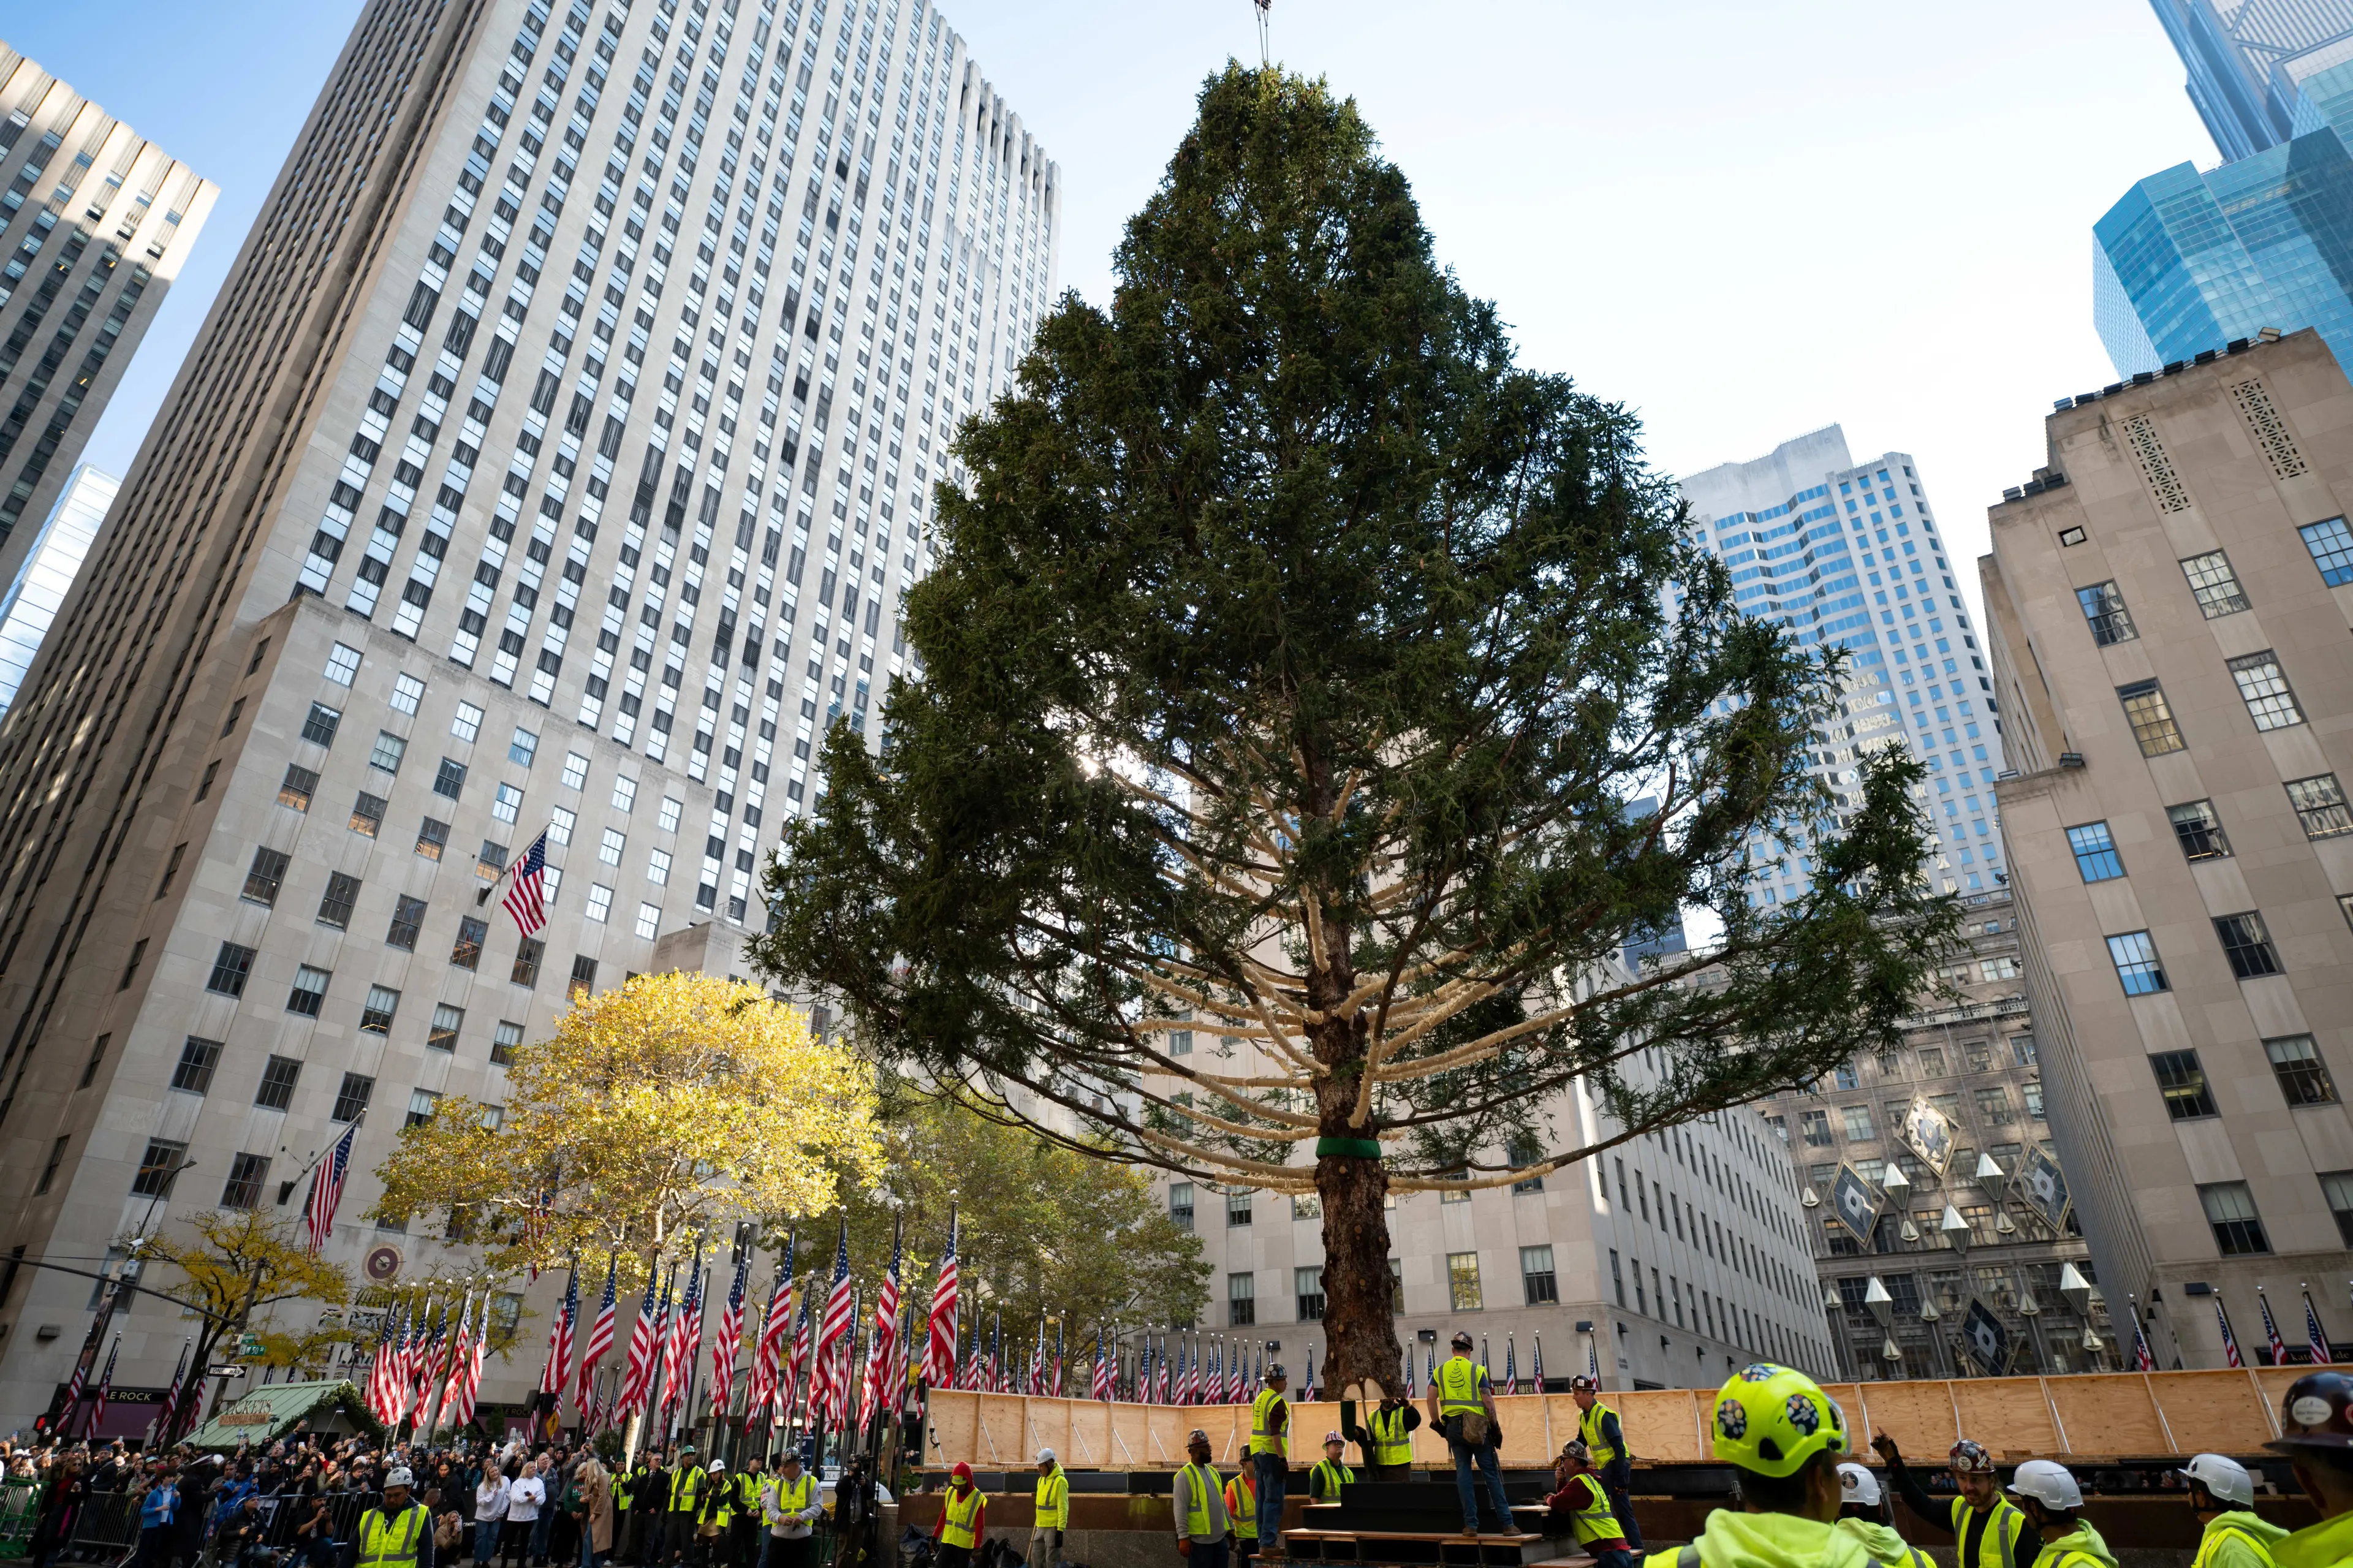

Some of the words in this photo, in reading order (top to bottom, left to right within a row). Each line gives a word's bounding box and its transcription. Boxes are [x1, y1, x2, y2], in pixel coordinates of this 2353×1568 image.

[252, 1346, 259, 1355] 50
[1494, 1385, 1507, 1395] ODD
[119, 1392, 152, 1401] ROCK
[224, 1399, 273, 1415] TICKETS
